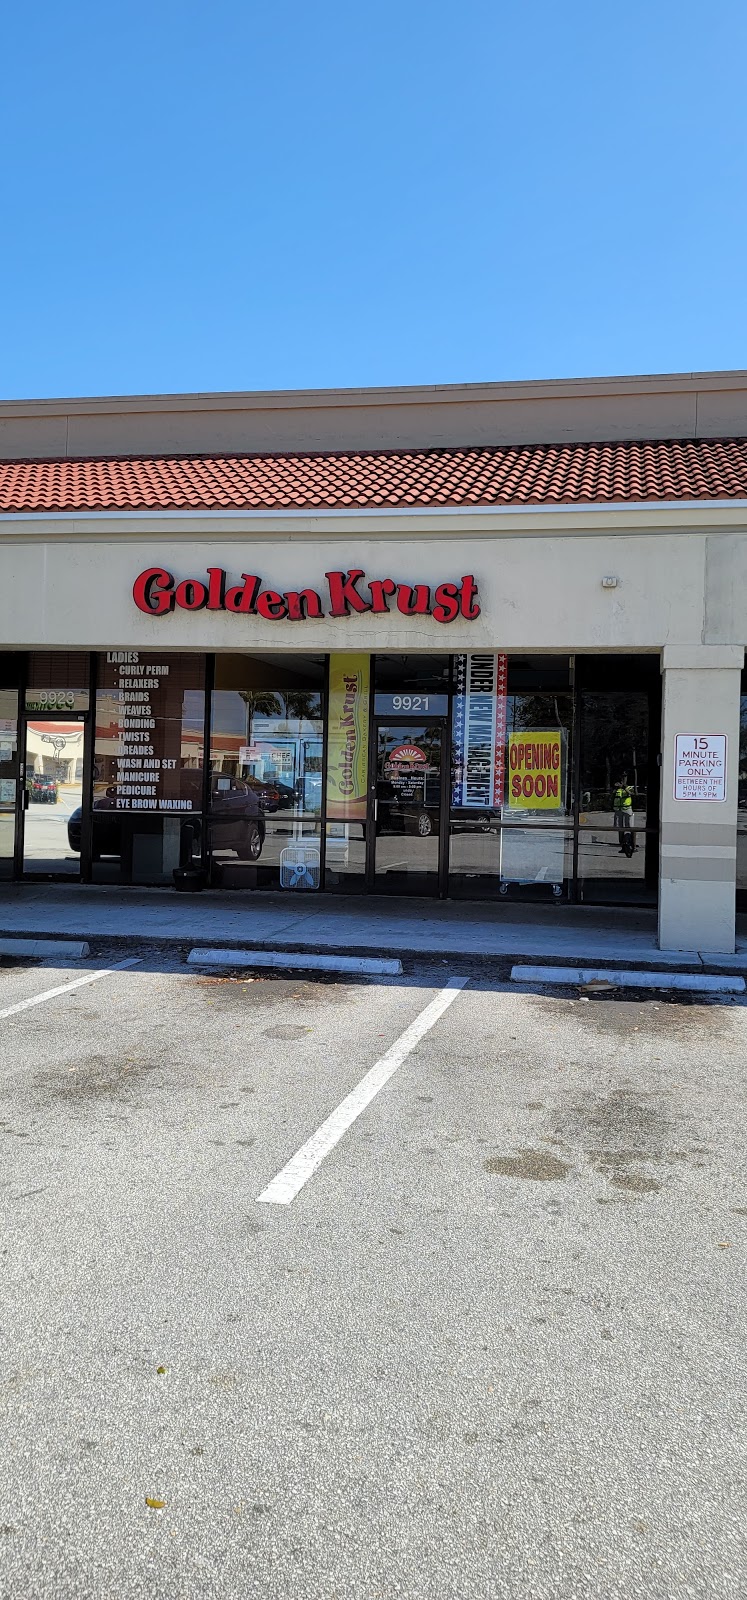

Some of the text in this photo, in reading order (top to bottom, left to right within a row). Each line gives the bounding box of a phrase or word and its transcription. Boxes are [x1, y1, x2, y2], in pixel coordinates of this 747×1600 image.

[133, 567, 481, 623] Golden Krust
[107, 652, 139, 663] LADIES
[119, 665, 169, 675] CURLY PERM
[119, 679, 159, 688] RELAXERS
[40, 691, 75, 704] 9923
[119, 692, 150, 702] BRAIDS
[340, 674, 358, 729] Krust
[392, 696, 429, 710] 9921
[119, 705, 151, 715] WEAVES
[118, 719, 155, 728] BONDING
[466, 654, 494, 805] UNDER NEW MANAGEMENT
[118, 732, 150, 742] TWISTS
[694, 738, 708, 750] 15
[338, 728, 357, 796] Golden
[510, 743, 560, 770] OPENING
[116, 759, 177, 769] WASH AND SET
[116, 772, 160, 782] MANICURE
[116, 786, 157, 796] PEDICURE
[512, 774, 558, 798] SOON
[116, 799, 192, 810] EYE BROW WAXING
